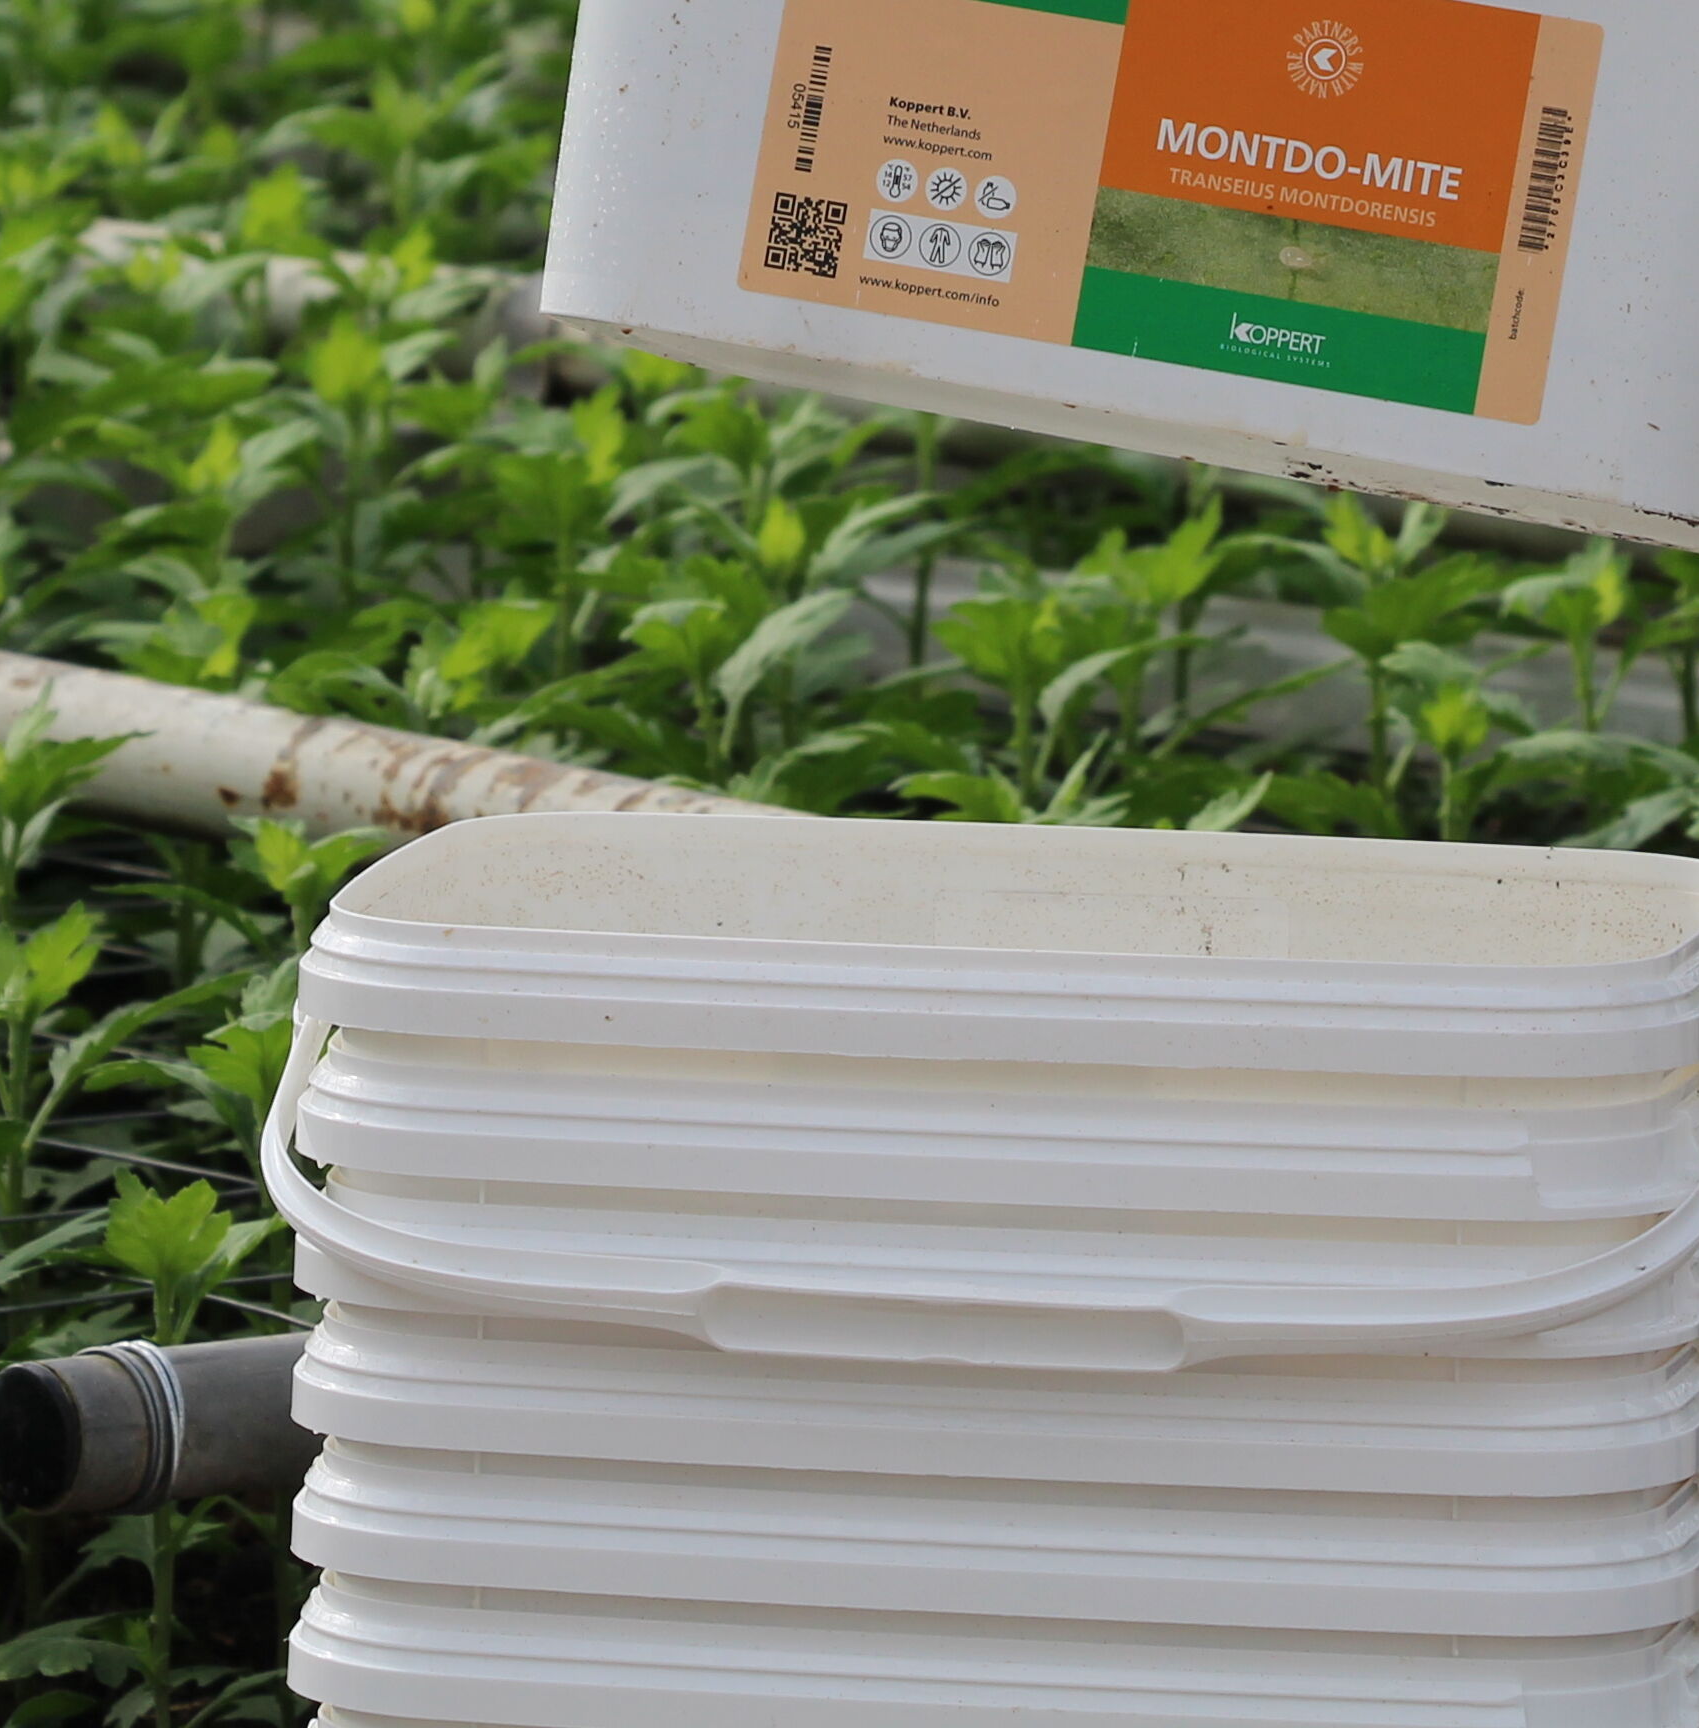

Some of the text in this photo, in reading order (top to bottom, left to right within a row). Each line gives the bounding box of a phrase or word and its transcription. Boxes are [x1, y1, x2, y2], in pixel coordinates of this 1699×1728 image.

[1285, 19, 1364, 99] PARTNERS WITH NATURE
[787, 83, 807, 129] 05415
[887, 114, 981, 141] The Netherlands
[889, 96, 972, 120] Koppert B.V.
[882, 134, 993, 162] www.koppert.com
[1156, 117, 1463, 201] MONTDO-MITE
[1168, 167, 1437, 228] TRANSEIUS MONTDORENSIS
[859, 275, 1000, 308] www.koppert.com/info
[1229, 311, 1326, 355] KOPPERT
[1508, 287, 1525, 341] batchcode:
[1219, 343, 1281, 360] BIOLOGICAL
